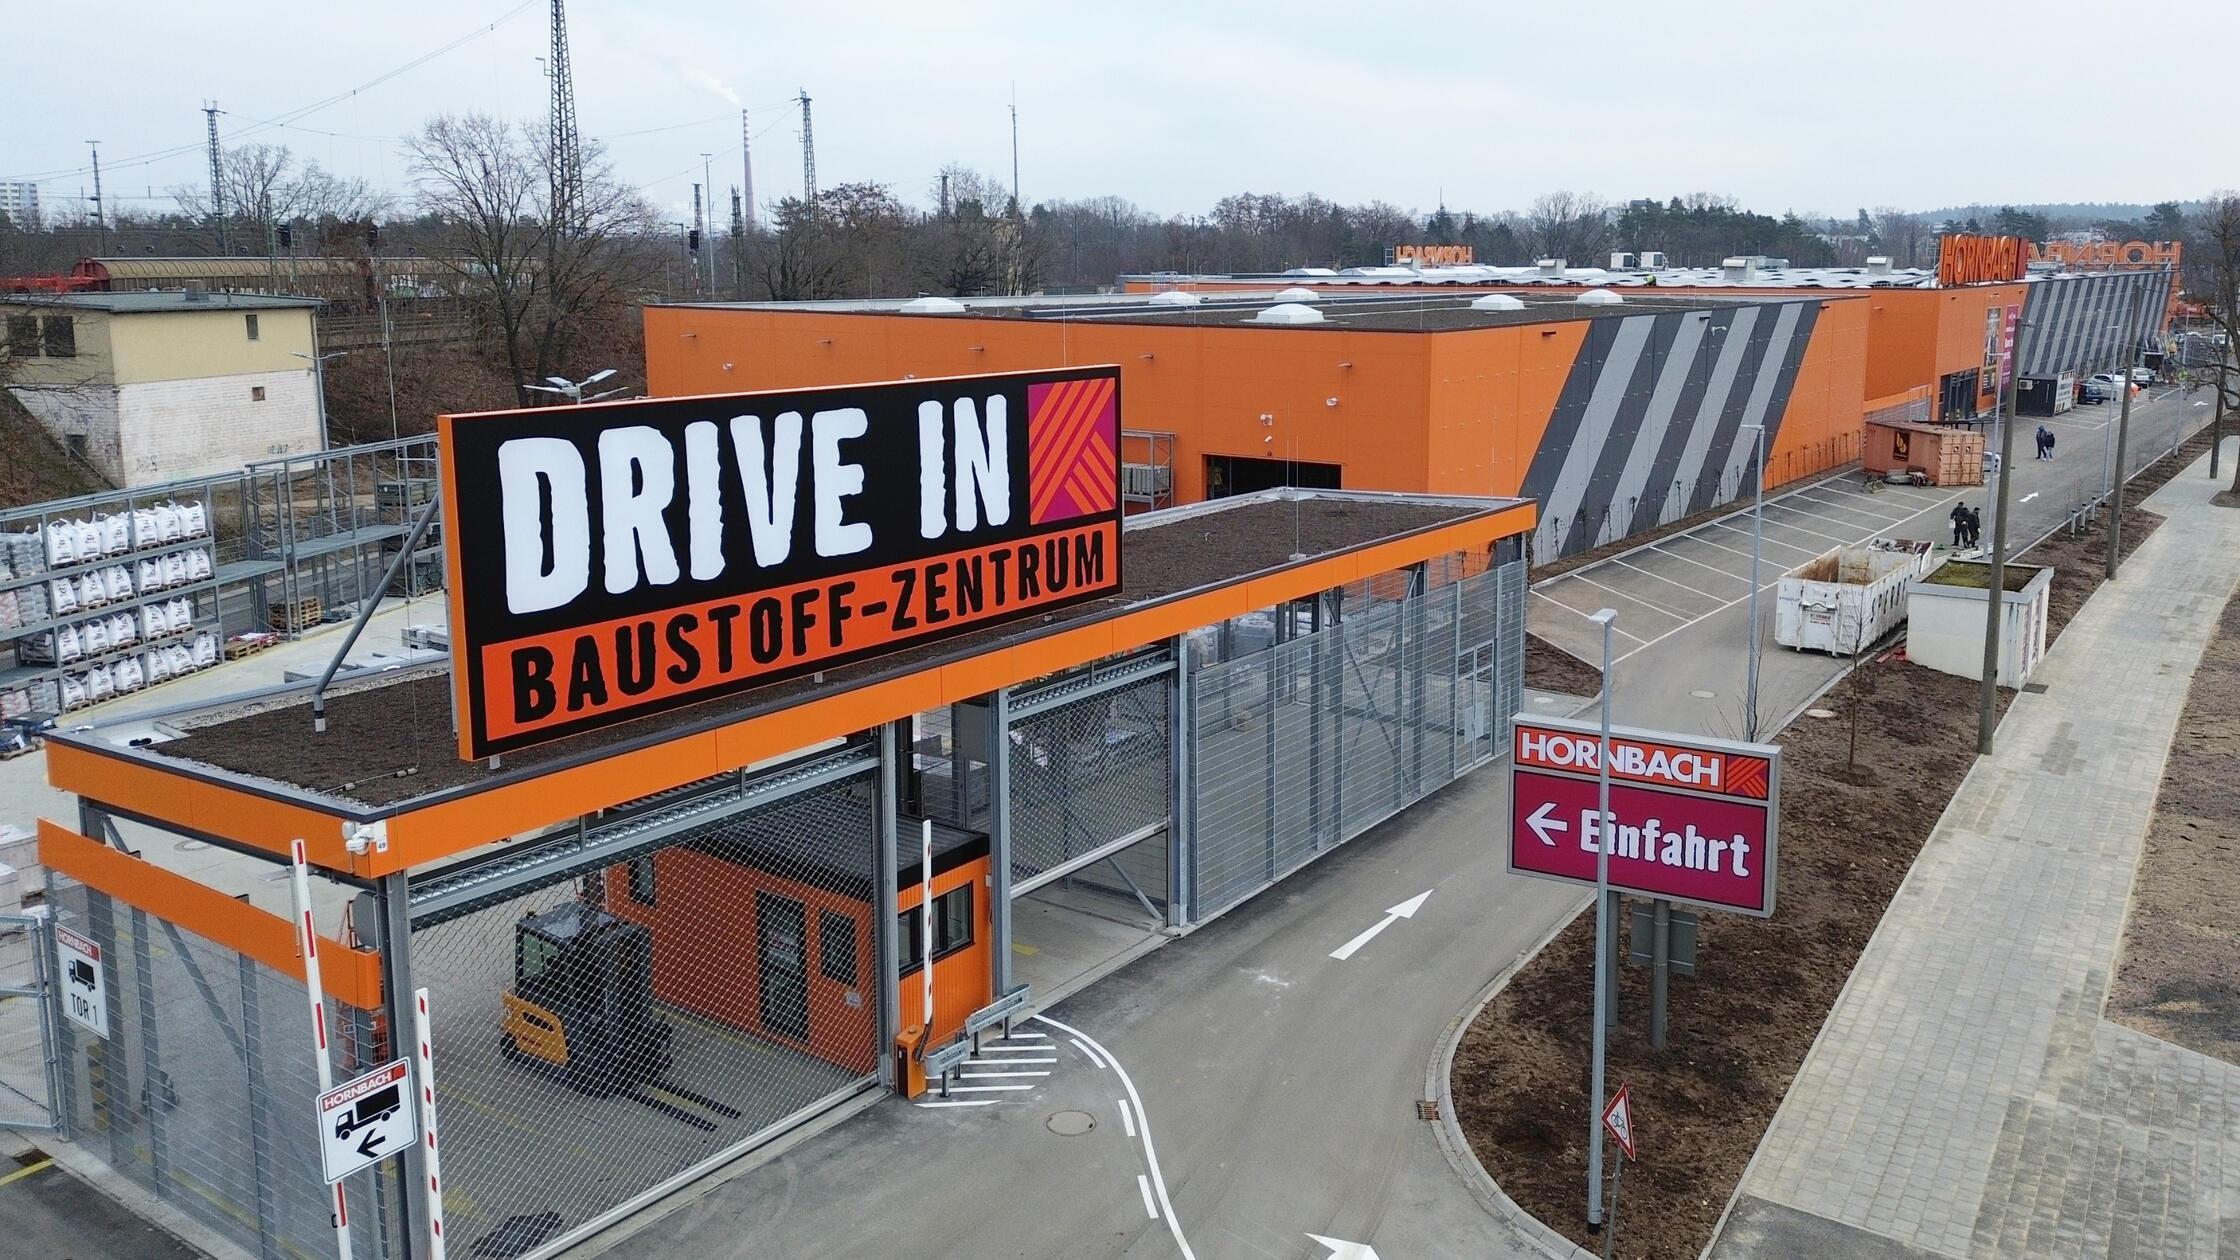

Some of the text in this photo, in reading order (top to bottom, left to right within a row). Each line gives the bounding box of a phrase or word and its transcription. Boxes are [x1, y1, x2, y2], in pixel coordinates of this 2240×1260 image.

[1941, 234, 2017, 285] HORNBACH
[498, 394, 1011, 615] DRIVE IN
[510, 529, 1105, 725] BAUSTOFF-ZENTRUM
[1521, 731, 1719, 787] HORNBACH
[1580, 808, 1751, 878] Einfahrt
[58, 930, 92, 957] HORNBACH
[70, 992, 98, 1026] TOR 1
[323, 1070, 393, 1110] HORNBACH
